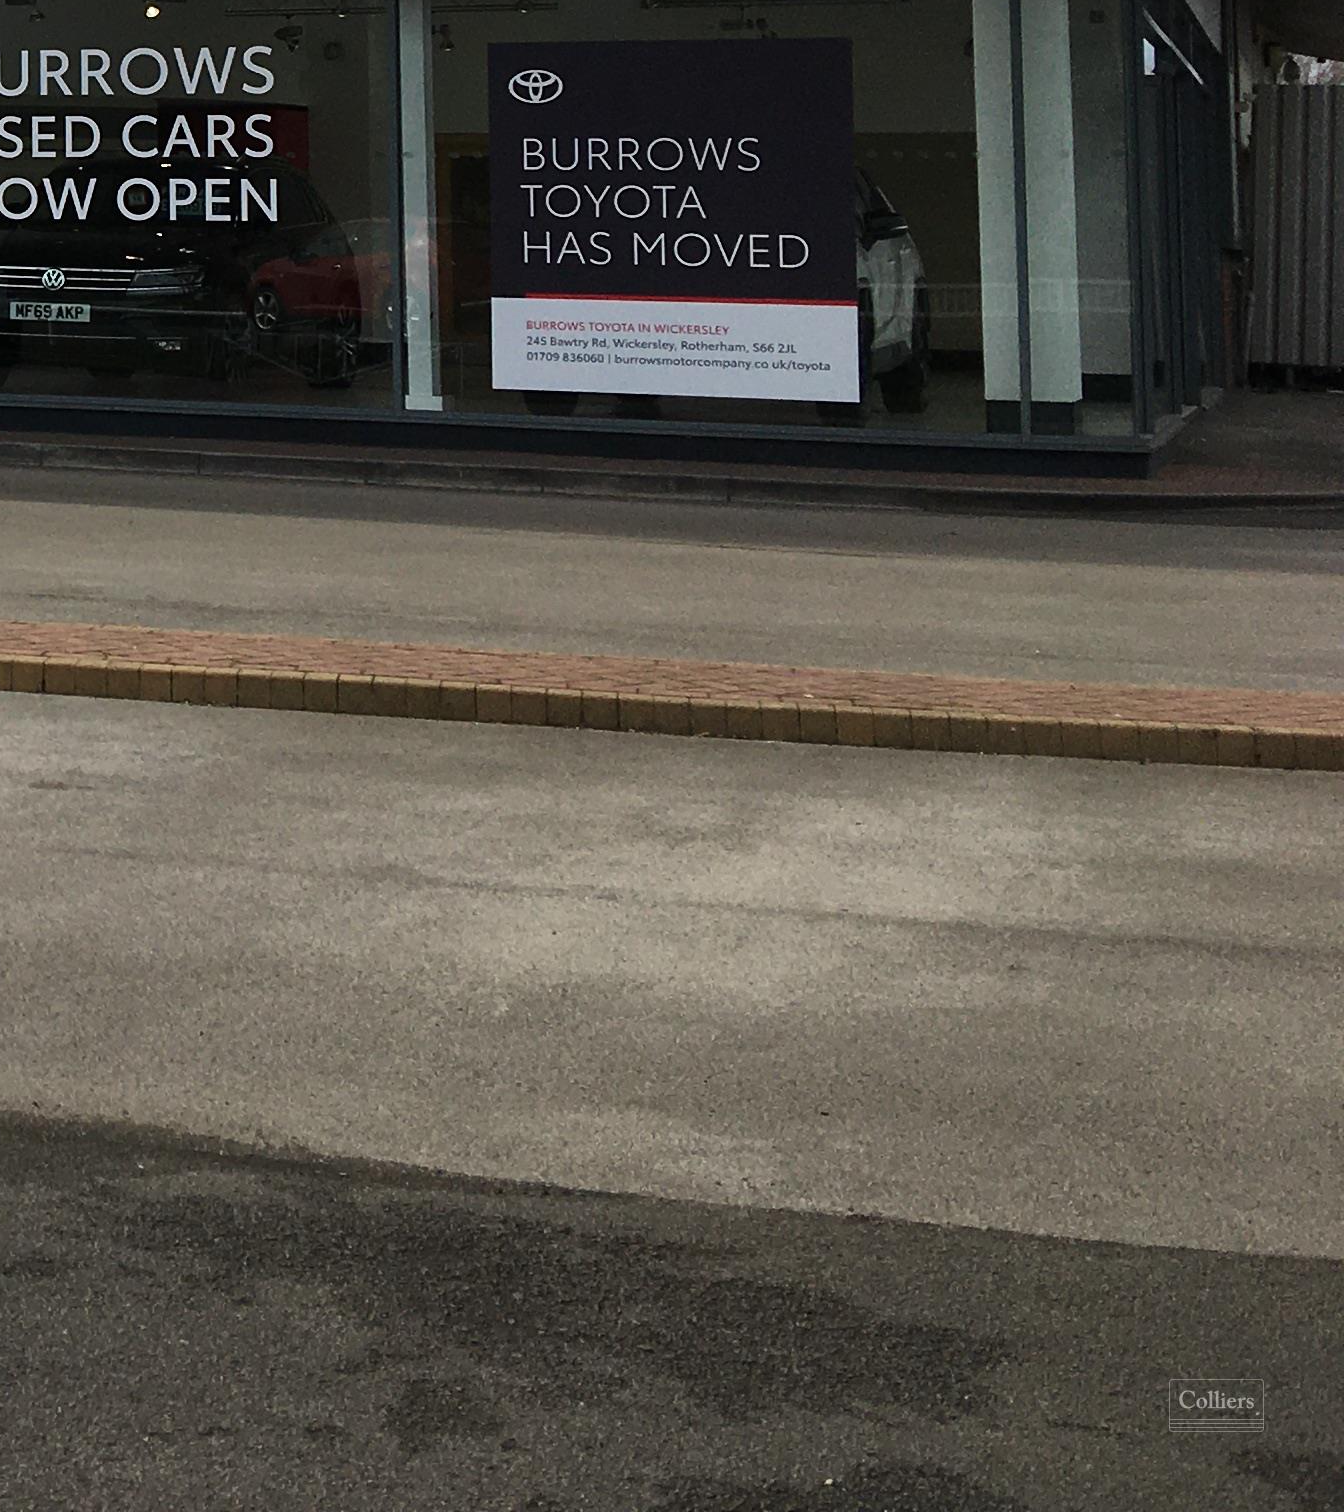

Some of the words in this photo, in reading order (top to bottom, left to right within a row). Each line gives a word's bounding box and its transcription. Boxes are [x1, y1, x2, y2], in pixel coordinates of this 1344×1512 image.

[122, 113, 275, 159] CARS
[522, 136, 761, 172] BURROWS
[116, 177, 278, 223] OPEN
[519, 184, 707, 220] TOYOTA
[523, 230, 612, 265] HAS
[633, 232, 810, 270] MOVED
[55, 305, 84, 319] AKP
[526, 320, 585, 332] BURROWS
[589, 321, 635, 333] TOYOTA
[638, 323, 651, 333] IN
[654, 324, 730, 336] WICKERSLEY
[526, 336, 547, 346] 245
[550, 336, 589, 350] Bawtry
[613, 339, 677, 353] Wickersley,
[681, 341, 749, 354] Rotherham,
[752, 342, 775, 353] S66
[778, 343, 798, 354] 2JL
[526, 351, 560, 362] 01709
